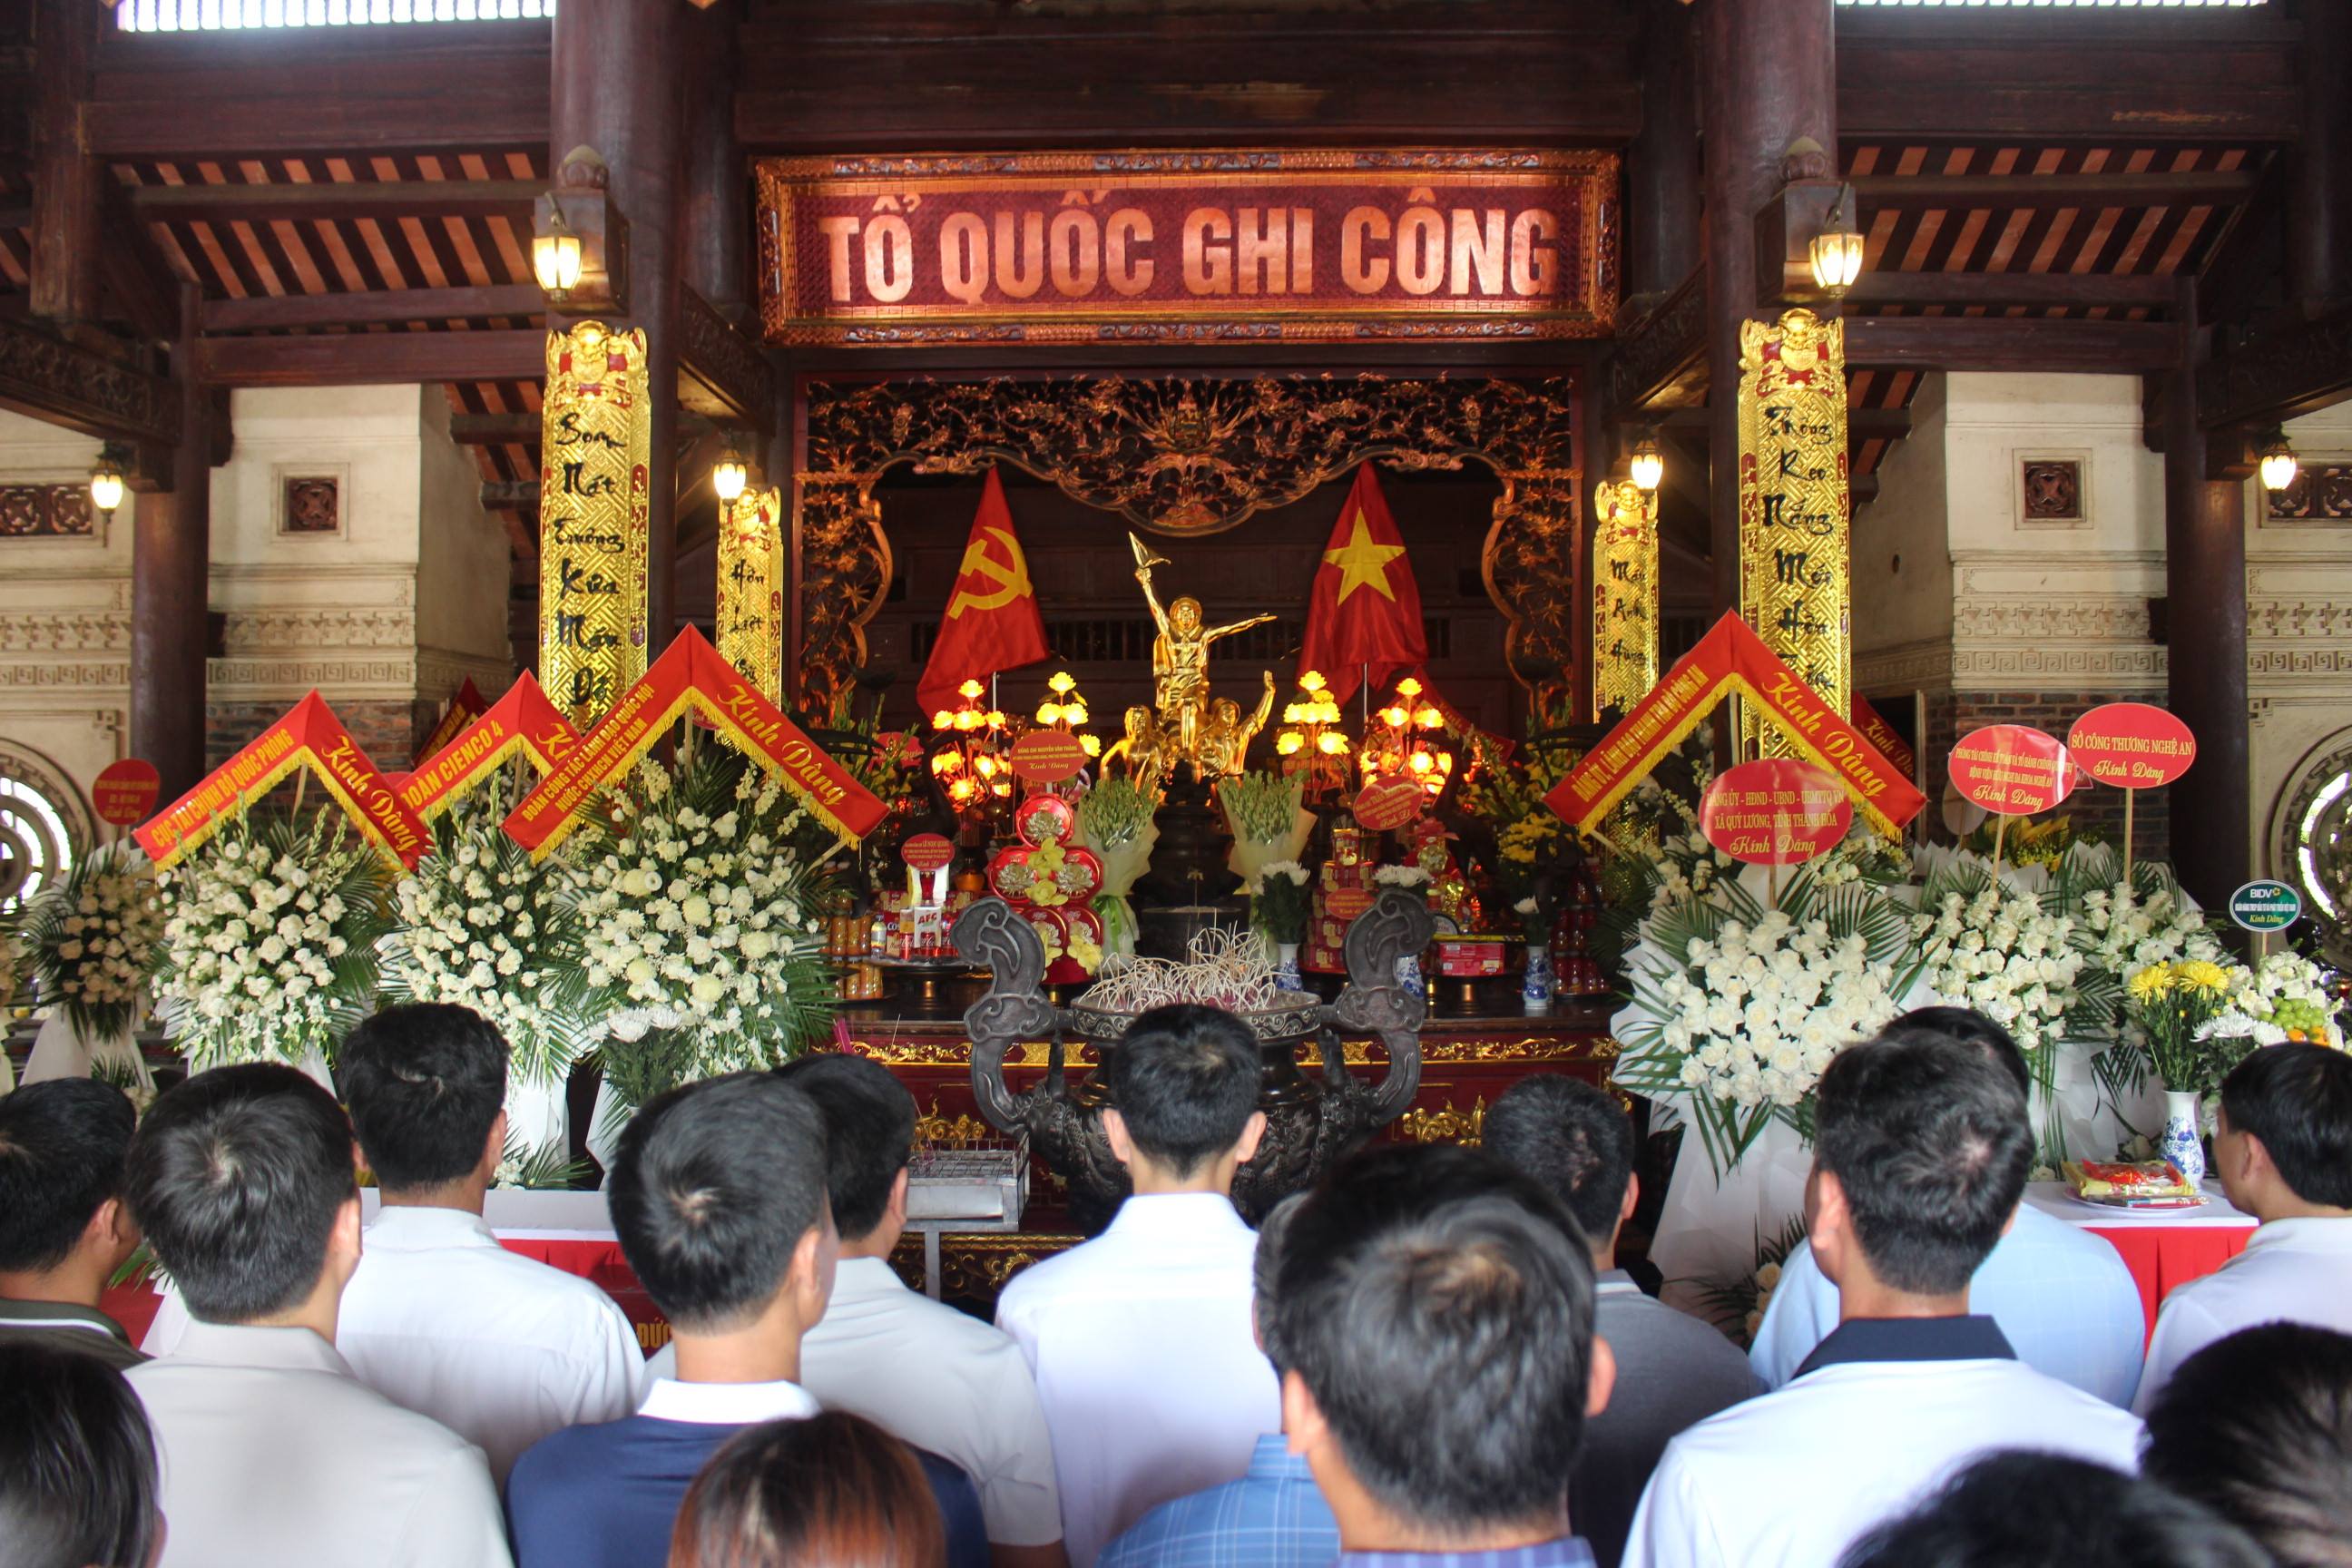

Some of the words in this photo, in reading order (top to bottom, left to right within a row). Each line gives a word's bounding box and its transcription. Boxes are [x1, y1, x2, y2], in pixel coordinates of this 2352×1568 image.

[818, 191, 922, 302] TỔ
[940, 190, 1154, 304] QUỐC
[1182, 207, 1313, 295] GHI
[1341, 187, 1559, 295] CÔNG
[1687, 664, 1710, 688] AN
[439, 728, 493, 783] CIENCO
[491, 720, 504, 738] 4
[522, 796, 549, 821] ĐOÀN
[544, 771, 571, 799] CÔNG
[564, 757, 585, 778] TÁC
[580, 738, 606, 763] LÃNH
[600, 720, 621, 740] ĐẠO
[615, 698, 641, 724] QUỐC
[635, 683, 654, 703] HỘI
[718, 684, 782, 747] Kính
[781, 740, 847, 805] Dâng
[1761, 672, 1826, 736] Kính
[1825, 730, 1887, 797] Dâng
[2072, 730, 2084, 749] SỞ
[2085, 732, 2111, 750] CÔNG
[2112, 736, 2150, 753] THƯƠNG
[2151, 738, 2178, 758] NGHỆ
[2179, 741, 2193, 755] AN
[187, 784, 224, 819] CHÍNH
[231, 752, 262, 786] QUỐC
[256, 729, 294, 766] PHÒNG
[555, 786, 582, 812] NƯỚC
[578, 754, 613, 790] CHXHCN
[607, 737, 629, 759] VIỆT
[624, 717, 647, 741] NAM
[2093, 760, 2128, 777] Kính
[2132, 761, 2164, 785] Dâng
[321, 735, 374, 797] Kính
[369, 789, 418, 851] Dâng
[1773, 790, 1795, 805] UBND
[1973, 785, 2005, 802] Kính
[2011, 789, 2043, 812] Dâng
[1730, 835, 1770, 855] Kính
[1777, 835, 1816, 860] Dâng
[2250, 888, 2272, 898] BIDV
[918, 912, 937, 925] AFC
